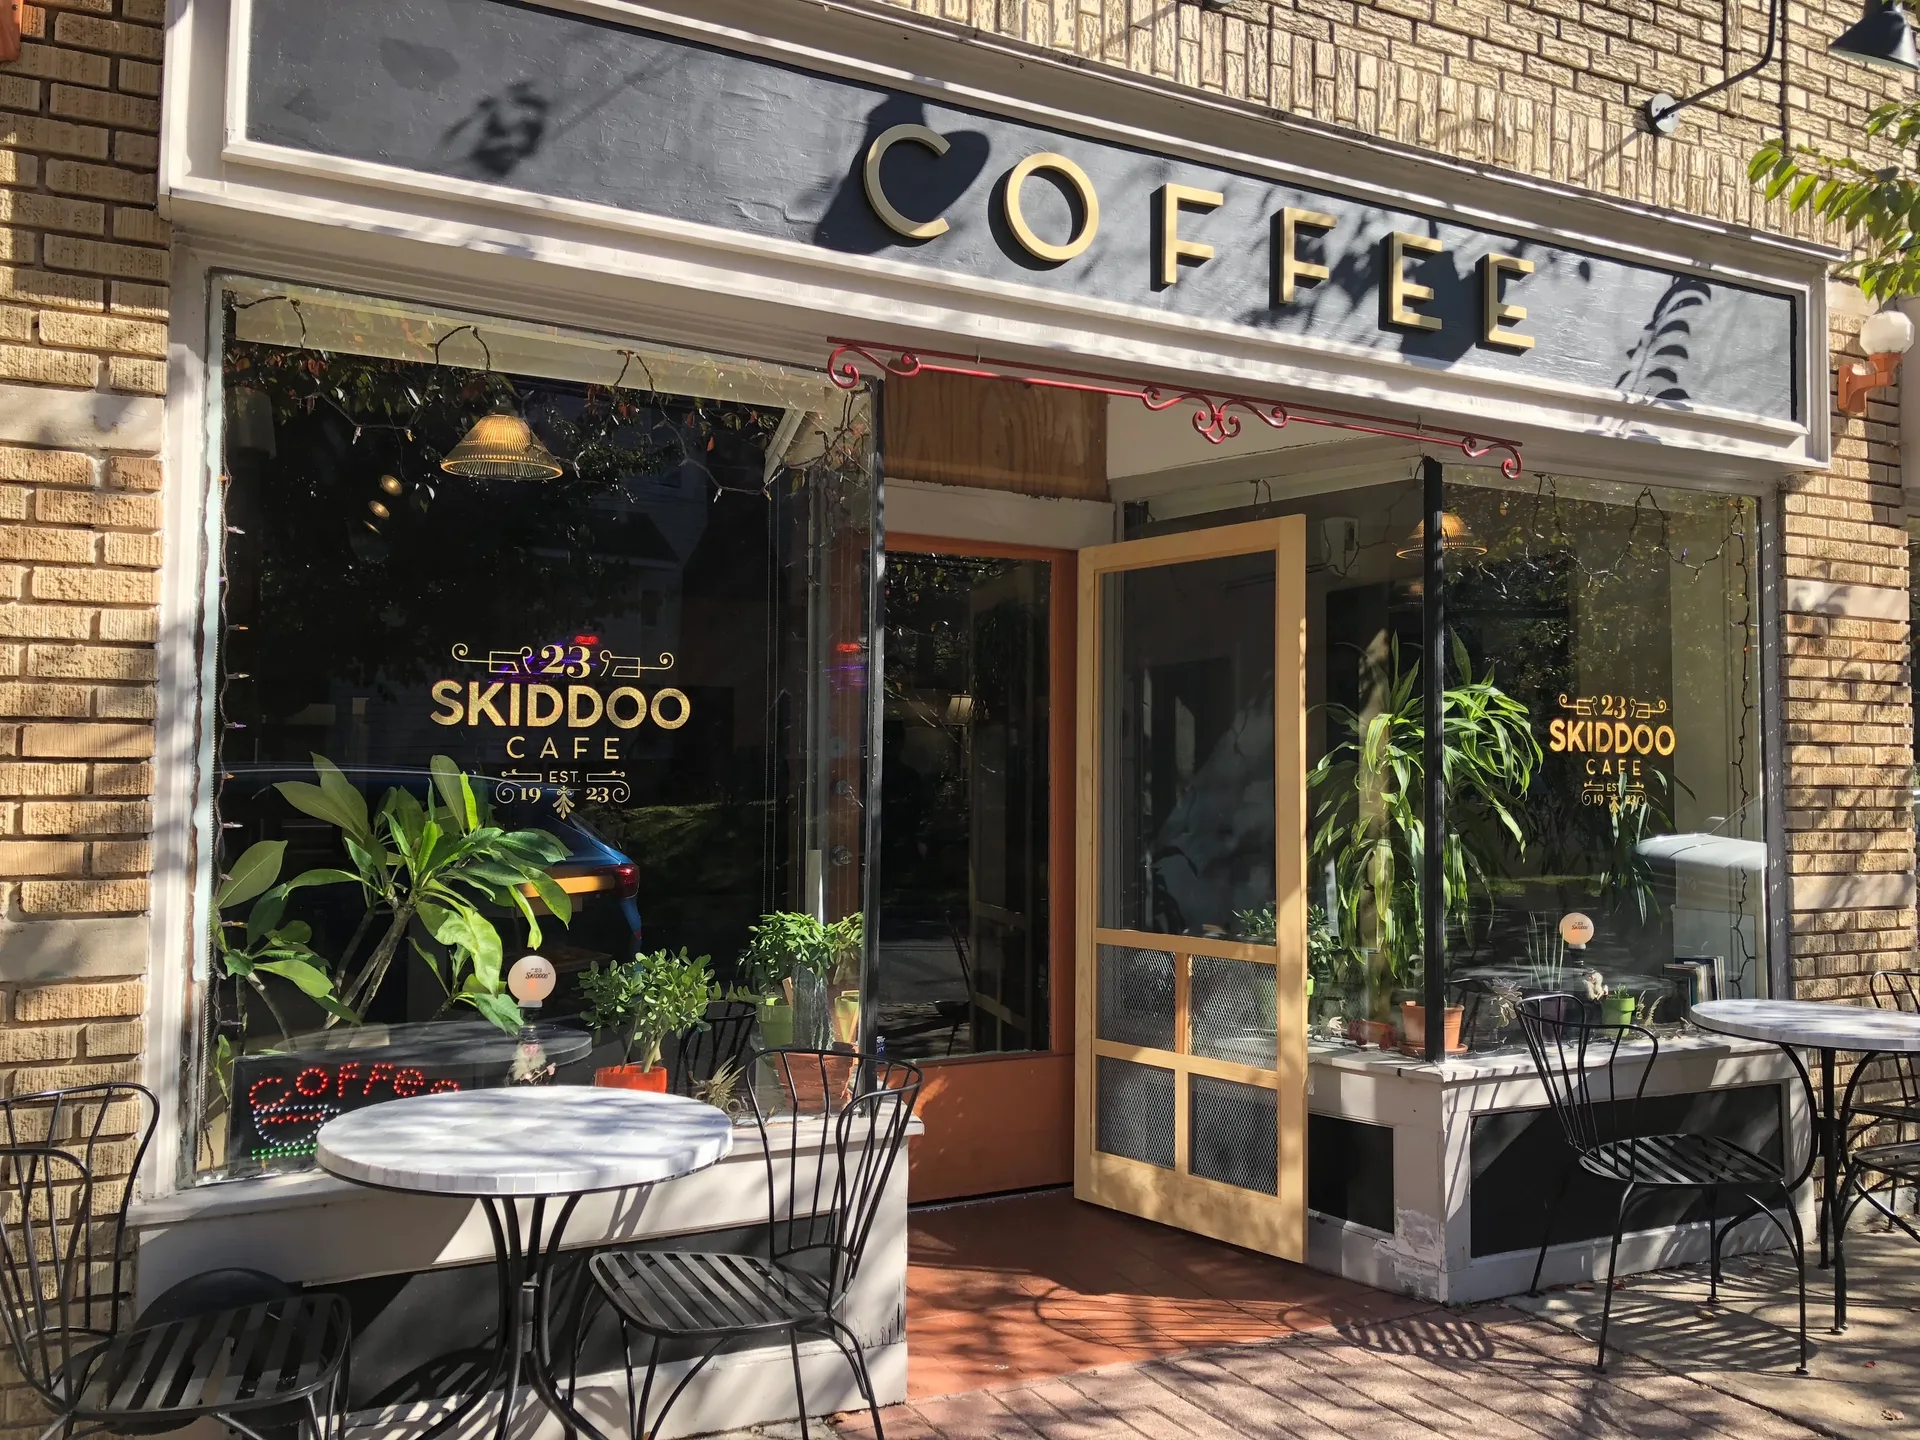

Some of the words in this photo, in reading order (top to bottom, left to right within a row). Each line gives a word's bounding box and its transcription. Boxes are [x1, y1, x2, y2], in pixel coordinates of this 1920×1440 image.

[863, 123, 1535, 349] COFFEE
[540, 644, 591, 679] 23
[430, 680, 691, 730] SKIDDOO
[1601, 694, 1626, 719] 23
[506, 736, 620, 759] CAFE
[1549, 719, 1676, 756] SKIDDOO
[549, 770, 581, 783] EST.
[1586, 759, 1641, 776] CAFE
[520, 787, 541, 804] 19
[586, 787, 609, 803] 23
[1593, 794, 1604, 806] 19
